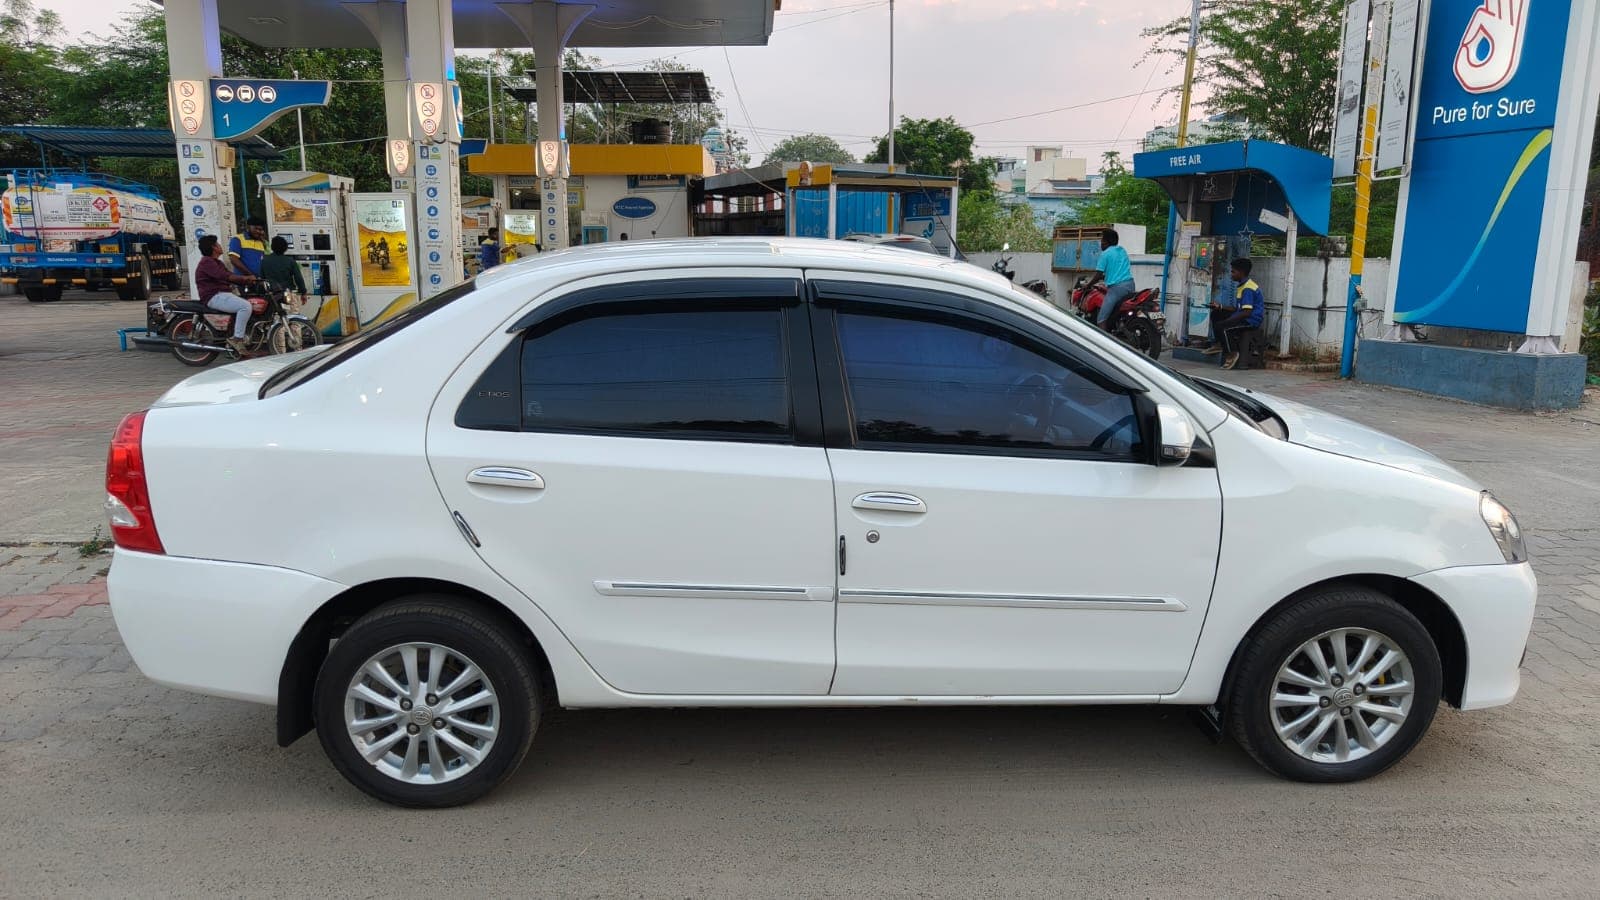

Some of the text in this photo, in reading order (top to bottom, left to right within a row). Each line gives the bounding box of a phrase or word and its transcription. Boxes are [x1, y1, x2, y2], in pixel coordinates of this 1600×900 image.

[1432, 97, 1536, 125] Pure for Sure
[222, 113, 230, 128] 1
[1170, 153, 1202, 168] FREE AIR
